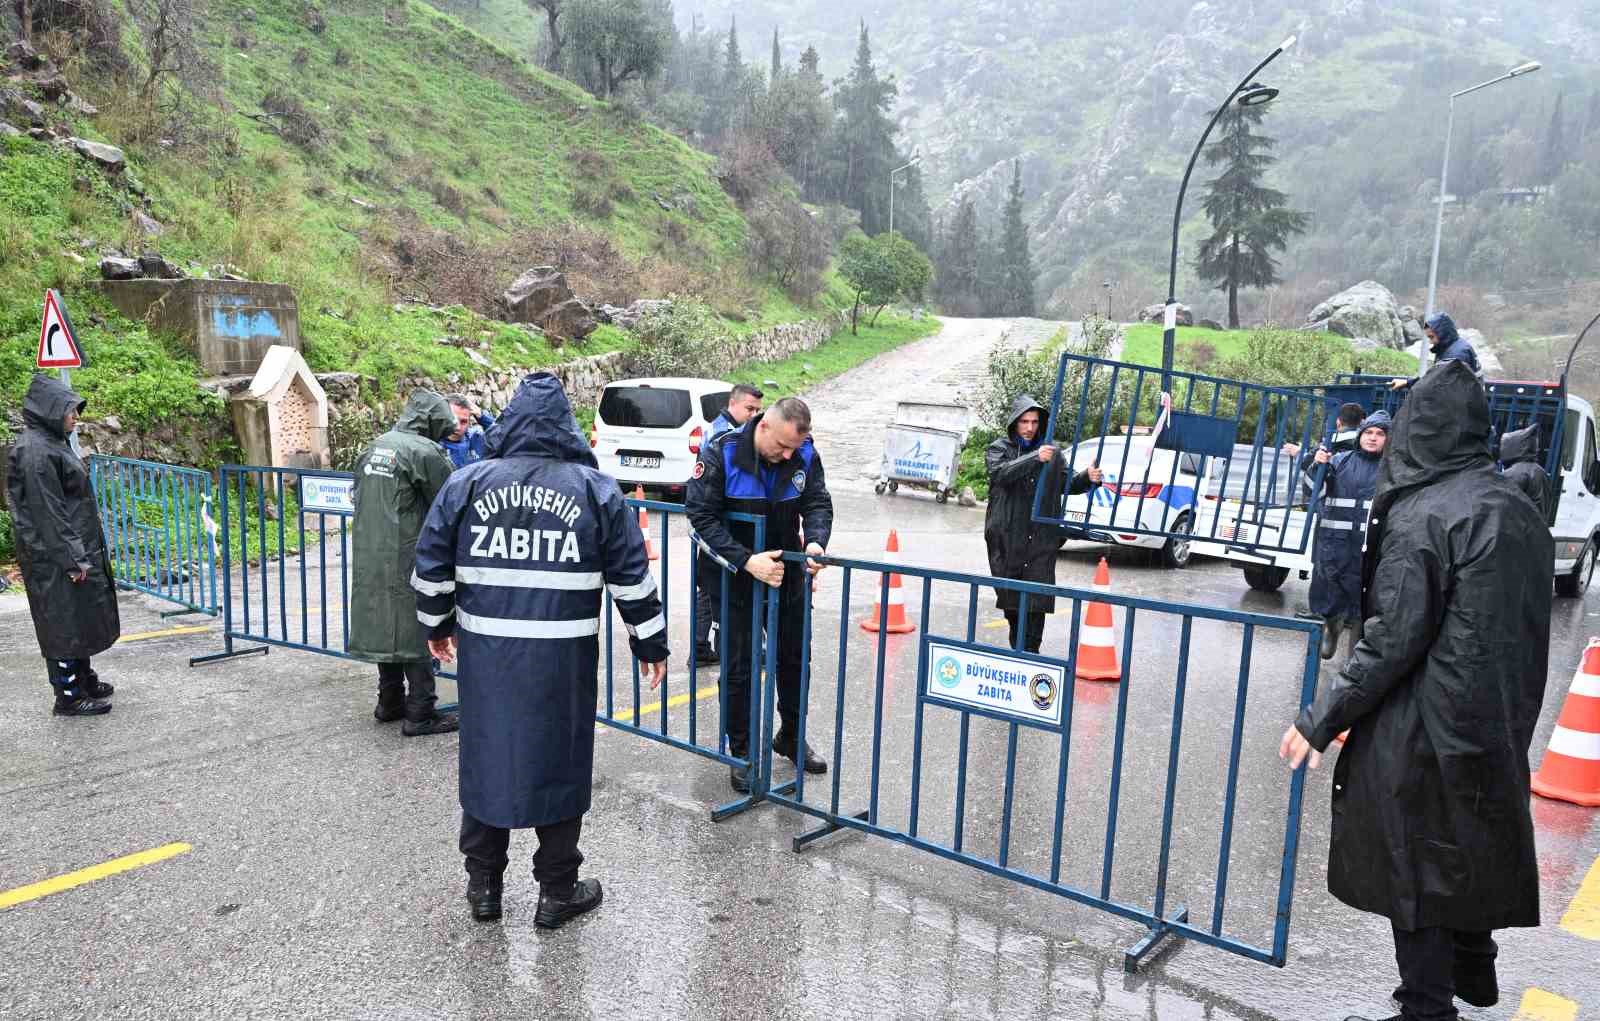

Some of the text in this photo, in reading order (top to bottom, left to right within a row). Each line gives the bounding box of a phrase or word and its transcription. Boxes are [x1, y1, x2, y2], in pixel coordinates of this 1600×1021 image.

[473, 480, 582, 528] BÜYÜKŞEHİR
[469, 525, 581, 563] ZABITA
[966, 661, 1028, 687] BÜYÜKŞEHİR
[977, 684, 1012, 702] ZABITA
